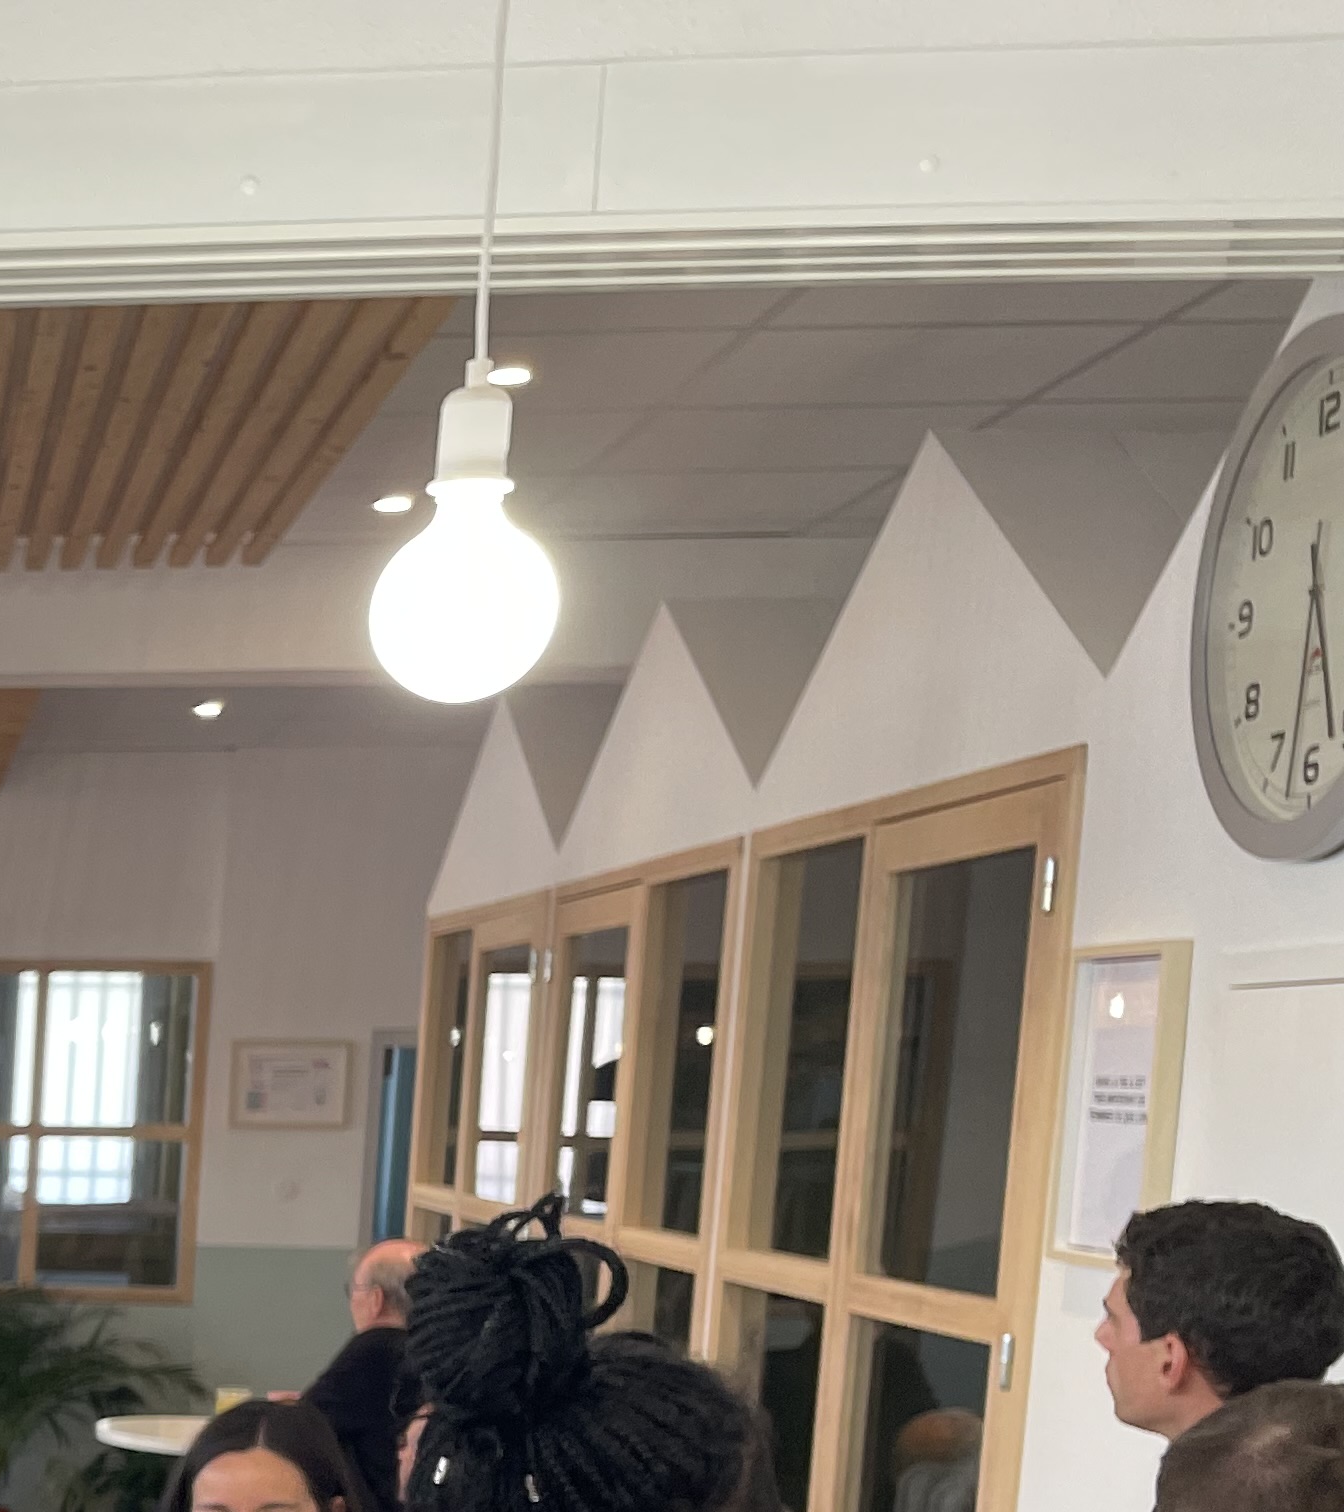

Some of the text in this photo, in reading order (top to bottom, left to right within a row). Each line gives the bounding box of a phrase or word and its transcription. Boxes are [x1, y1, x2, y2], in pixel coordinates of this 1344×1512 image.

[1318, 390, 1341, 437] 12
[1282, 440, 1296, 481] 11
[1251, 516, 1274, 562] 10
[1238, 599, 1254, 639] 9
[1245, 682, 1260, 721] 8
[1270, 730, 1286, 773] 7
[1303, 743, 1320, 786] 6
